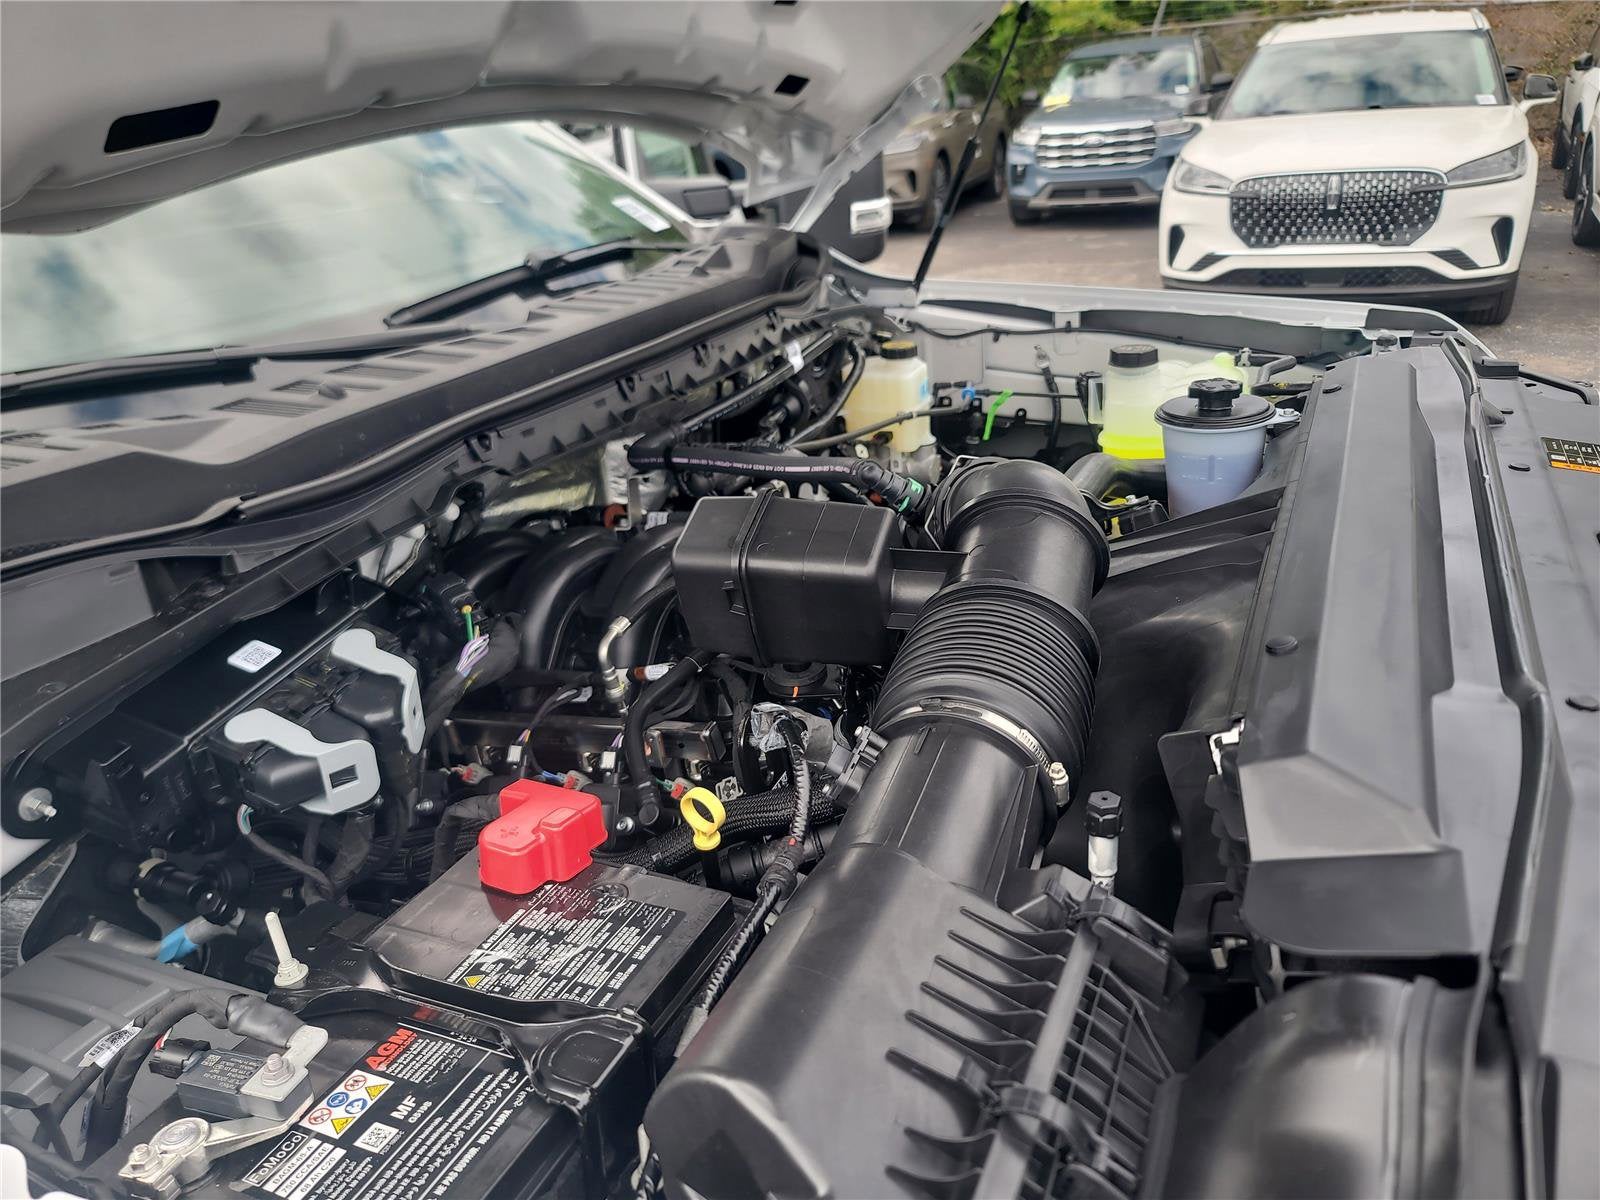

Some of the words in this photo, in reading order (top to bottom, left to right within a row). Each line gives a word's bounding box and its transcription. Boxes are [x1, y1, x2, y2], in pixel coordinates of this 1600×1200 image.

[365, 1028, 414, 1069] AGM
[390, 1095, 419, 1119] MF
[248, 1134, 303, 1183] FoMoCo
[271, 1145, 314, 1184] BAGM-65-A
[281, 1179, 297, 1192] 750
[294, 1146, 330, 1179] CCA/SAE
[308, 1171, 322, 1182] Ah
[319, 1156, 337, 1171] C20
